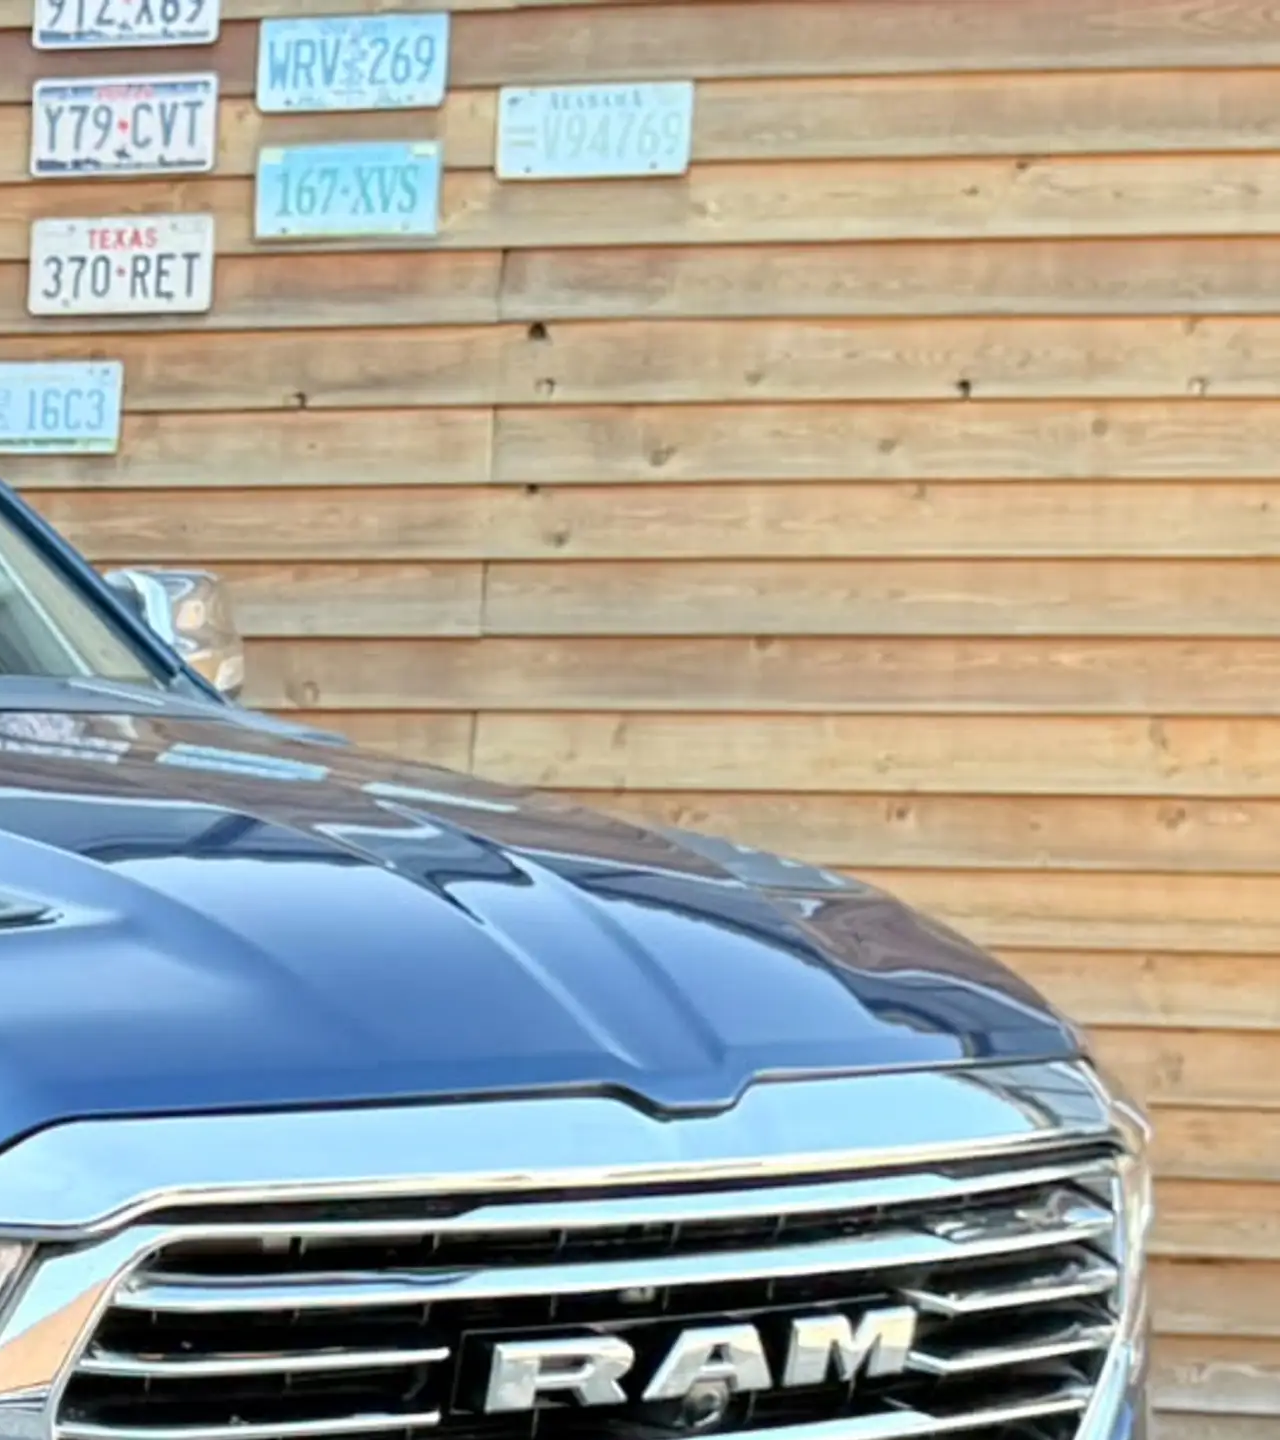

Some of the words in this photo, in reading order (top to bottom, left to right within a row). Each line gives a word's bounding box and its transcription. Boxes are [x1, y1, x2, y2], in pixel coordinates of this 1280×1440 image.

[268, 38, 340, 91] WRV
[368, 34, 436, 85] 269
[44, 103, 113, 153] Y79
[131, 100, 205, 149] CVT
[87, 227, 159, 250] TEXAS
[42, 254, 112, 300] 370
[129, 252, 202, 299] RET
[27, 387, 107, 431] 16C3
[483, 1304, 918, 1415] RAM
